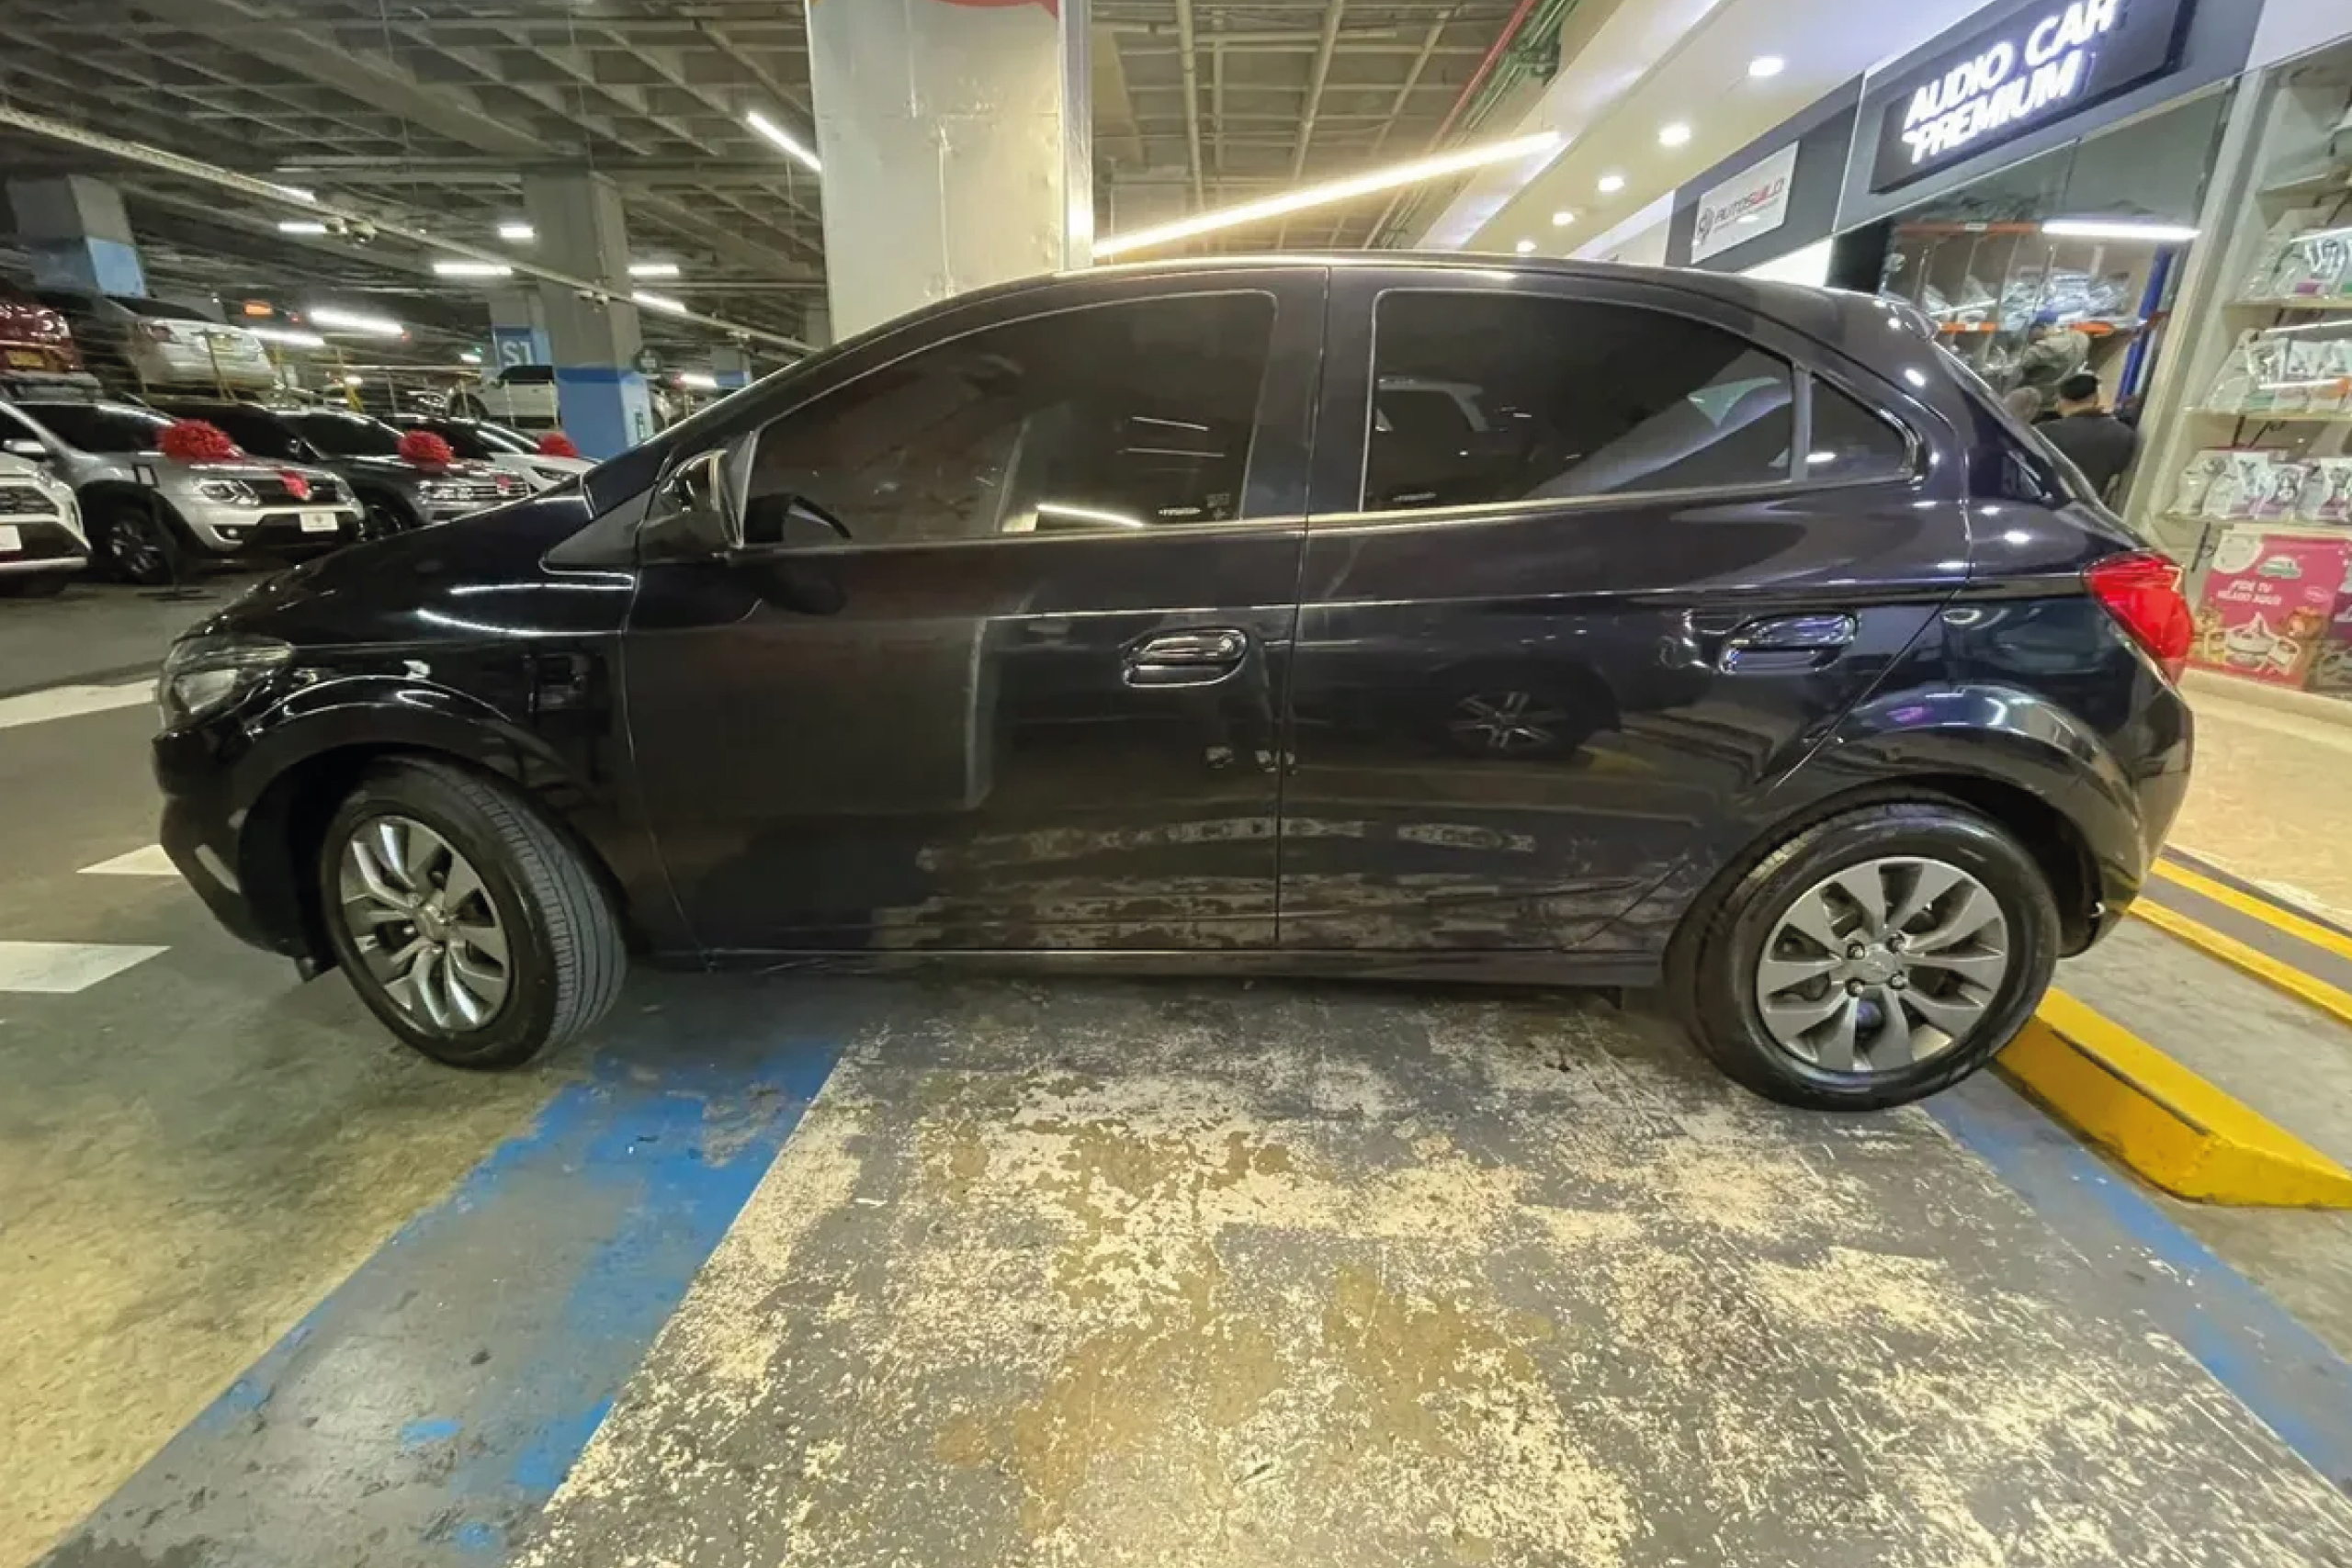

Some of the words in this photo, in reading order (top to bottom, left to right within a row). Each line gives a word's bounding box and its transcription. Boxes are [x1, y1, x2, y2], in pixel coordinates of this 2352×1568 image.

[1901, 50, 2083, 164] PREMIUM
[1904, 41, 2015, 130] AUDIO
[2024, 0, 2116, 66] CAR
